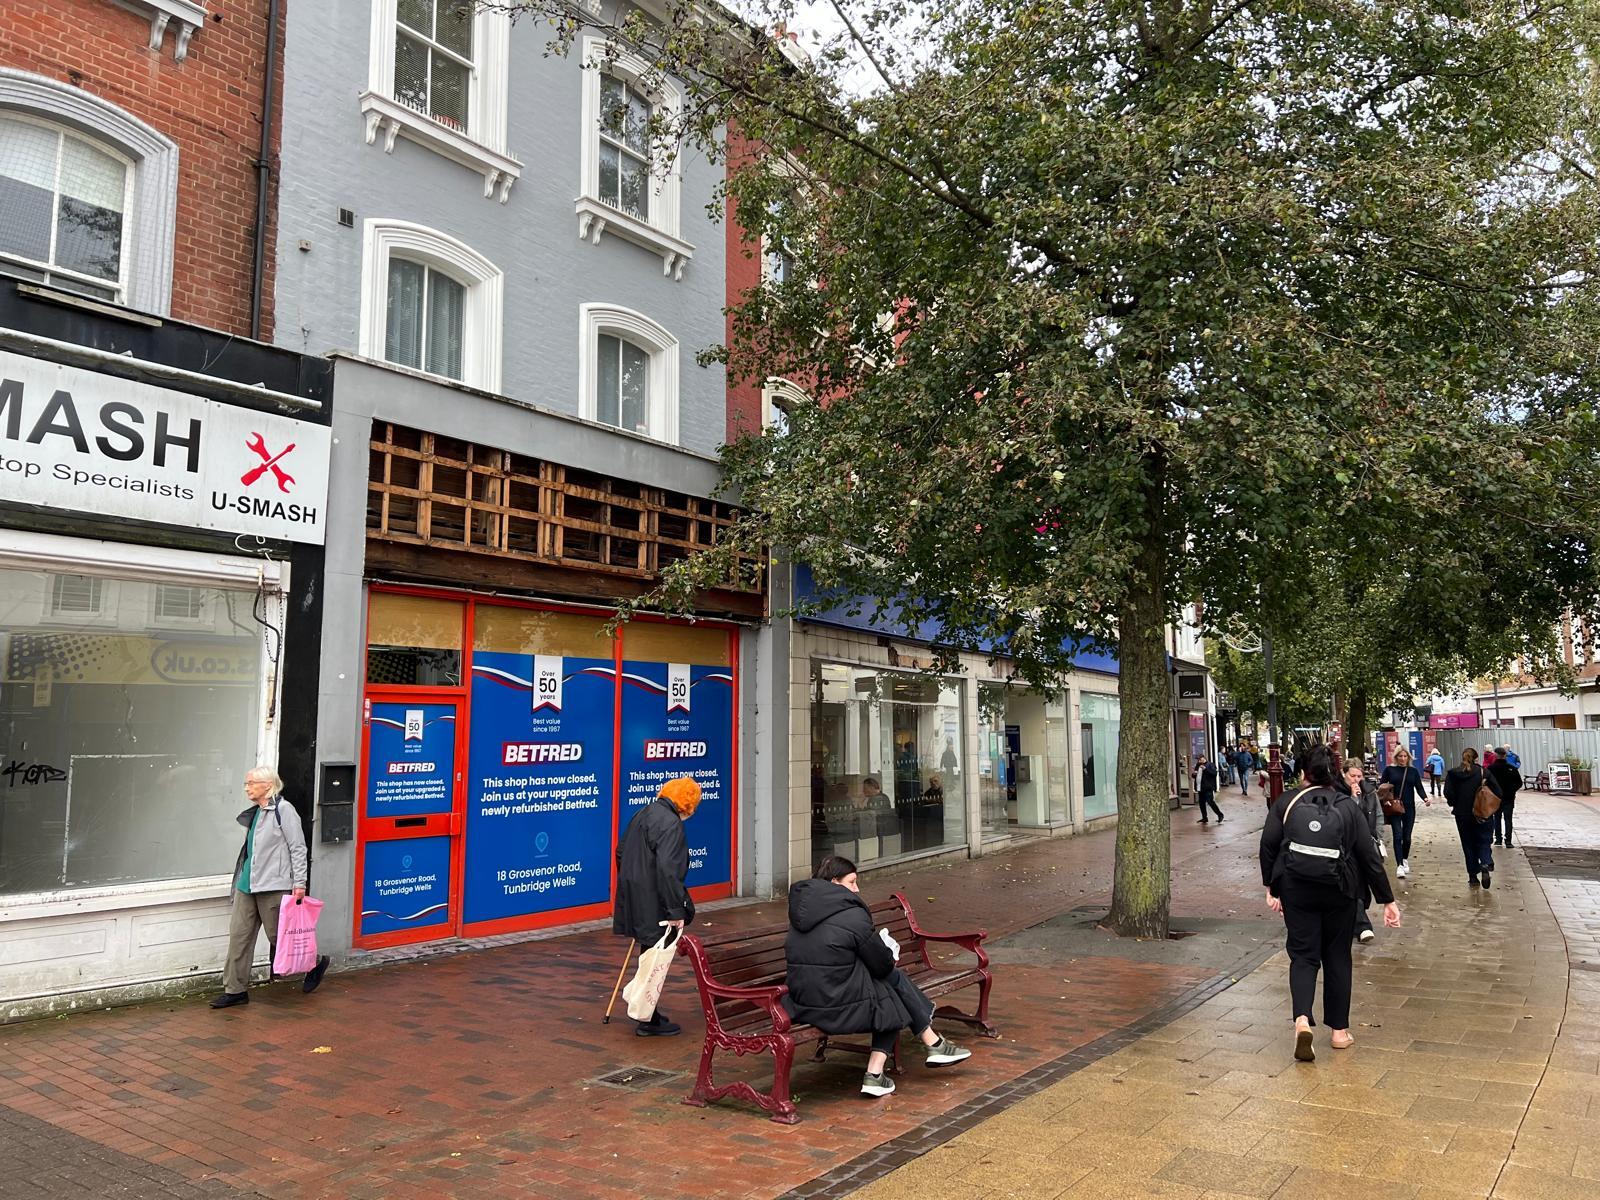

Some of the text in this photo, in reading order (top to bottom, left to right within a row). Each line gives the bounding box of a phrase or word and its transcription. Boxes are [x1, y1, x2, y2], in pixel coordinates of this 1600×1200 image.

[52, 463, 194, 500] Specialists
[211, 491, 317, 525] U-SMASH
[539, 677, 557, 693] 50
[672, 683, 686, 697] 50
[409, 722, 420, 731] 50
[505, 743, 582, 763] BETFRED
[646, 741, 707, 758] BETFRED
[389, 762, 436, 773] BETFRED
[483, 773, 597, 789] This shop has now closed.
[629, 769, 718, 781] This shop has now closed.
[389, 780, 402, 788] shop
[402, 787, 415, 795] your
[415, 786, 441, 794] upgraded
[628, 784, 645, 793] Join
[375, 795, 393, 803] newly
[480, 786, 600, 803] Join us at your upgraded &
[628, 796, 651, 805] newly
[481, 798, 598, 818] newly refurbished Betfred.
[688, 847, 708, 857] Road,
[496, 861, 582, 881] 18 Grosvenor Road,
[383, 876, 417, 886] Grosvenor
[418, 873, 437, 882] Road,
[503, 876, 576, 895] Tunbridge Wells
[379, 886, 414, 896] Tunbridge
